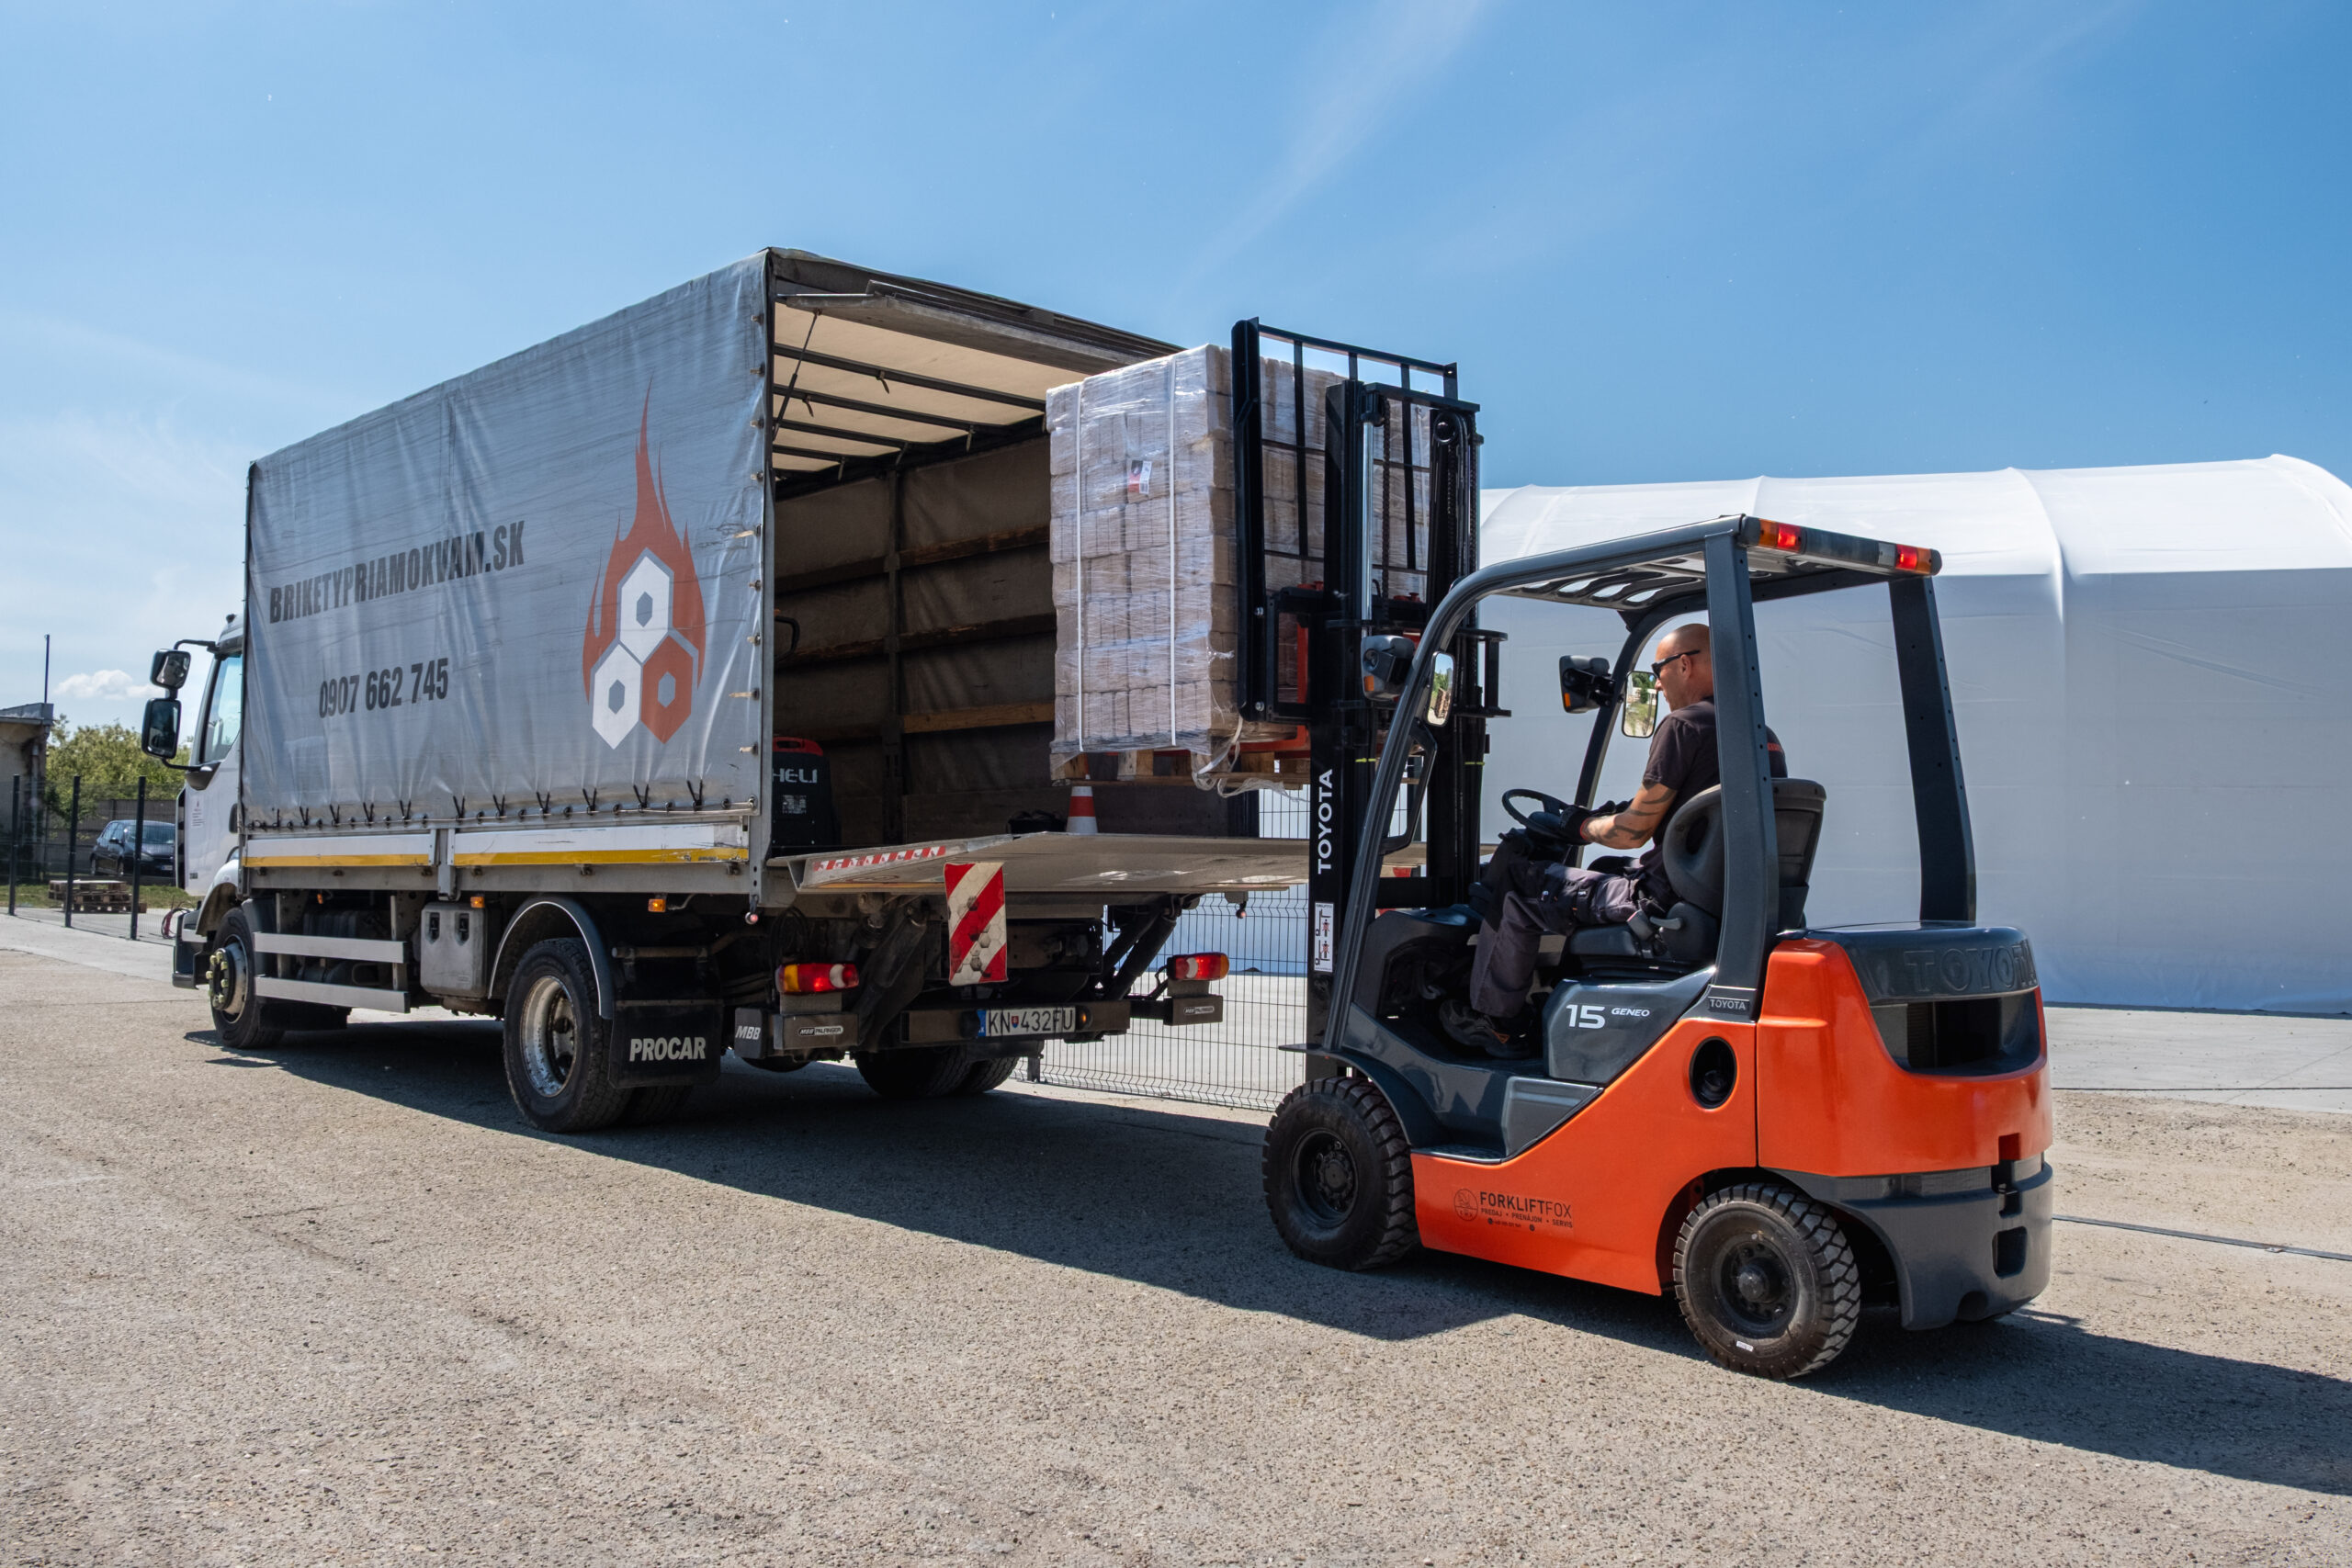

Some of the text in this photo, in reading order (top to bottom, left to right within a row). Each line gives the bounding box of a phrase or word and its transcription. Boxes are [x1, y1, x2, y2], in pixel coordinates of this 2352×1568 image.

[319, 657, 449, 718] 0907 662 745
[1317, 769, 1333, 874] TOYOTA
[1566, 1003, 1651, 1029] 15 GENEO
[1709, 998, 1747, 1011] TOYOTA
[735, 1025, 761, 1040] MBB
[629, 1036, 707, 1062] PROCAR
[1480, 1190, 1572, 1219] FORKLIFTFOX
[1481, 1207, 1502, 1217] PREDAJ
[1553, 1218, 1573, 1228] SERVIS
